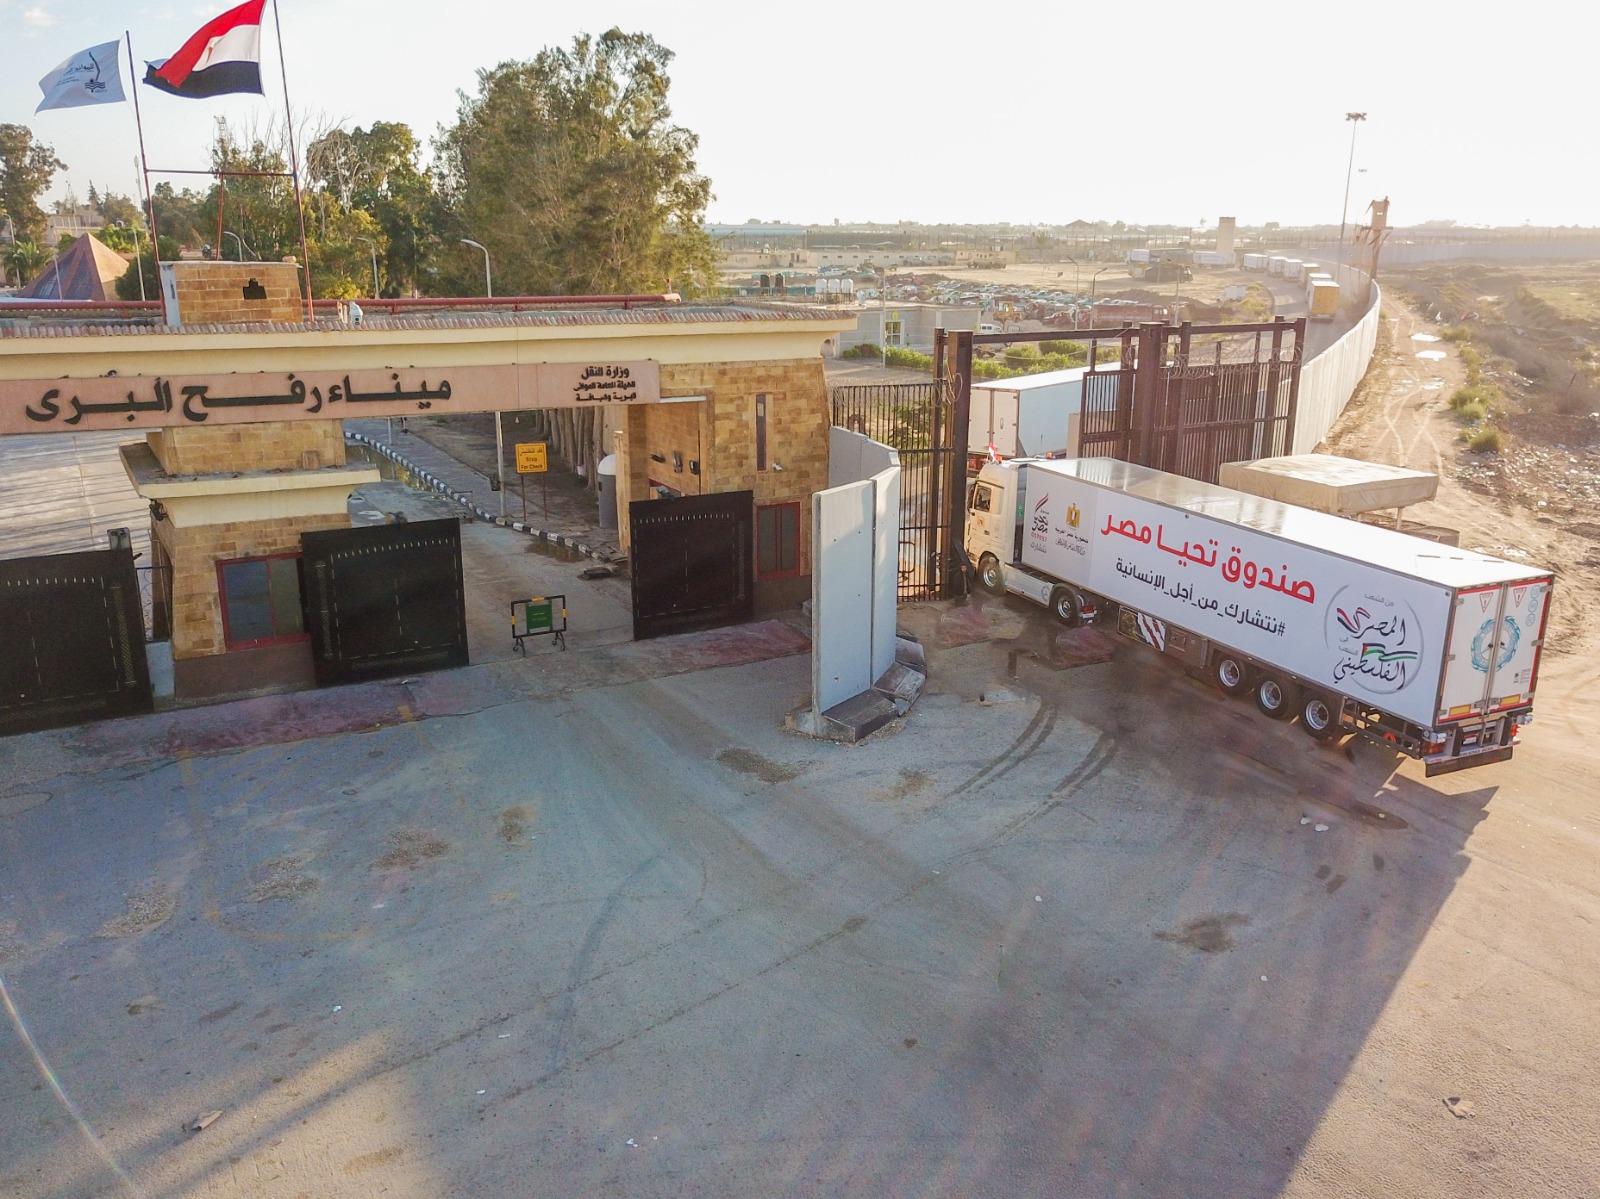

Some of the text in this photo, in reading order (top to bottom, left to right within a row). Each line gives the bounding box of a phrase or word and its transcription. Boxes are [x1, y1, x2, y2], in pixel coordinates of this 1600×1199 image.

[328, 372, 452, 410] ميناء
[581, 365, 630, 380] وزارة النقل
[181, 372, 322, 422] رفح
[1100, 514, 1316, 604] صندوق تحيا مصر
